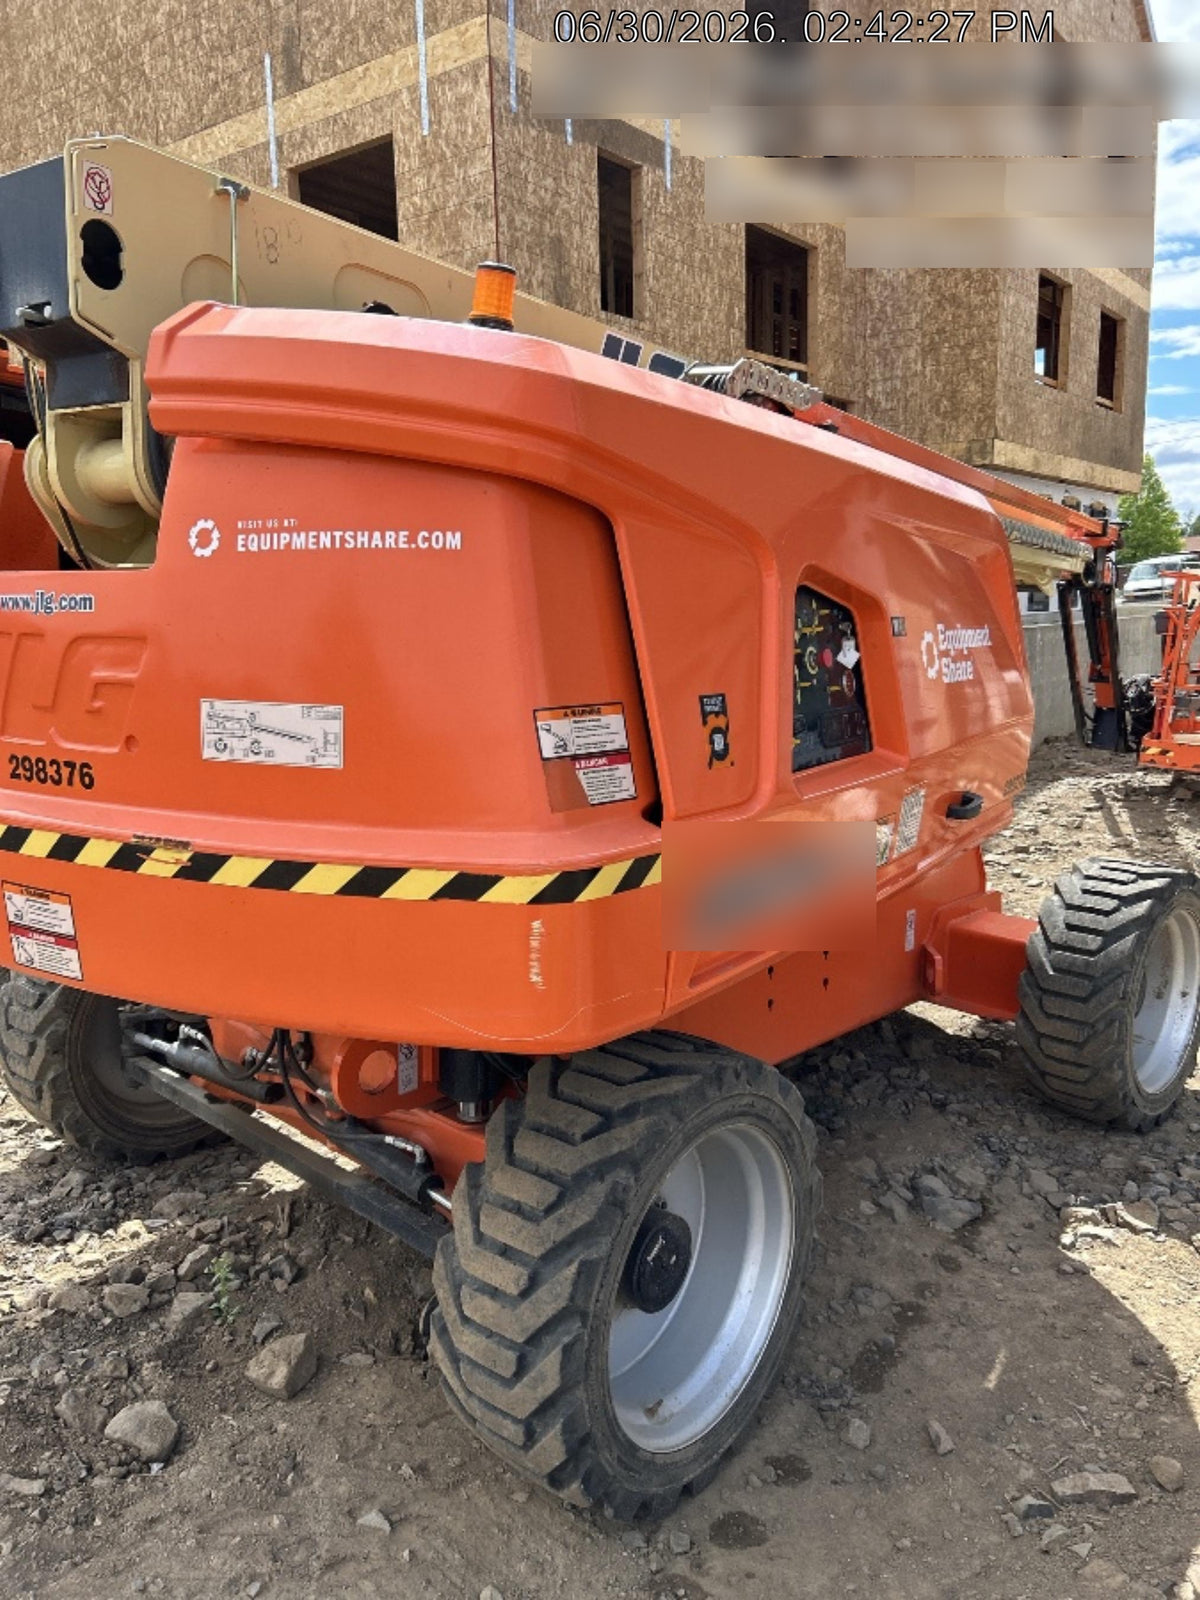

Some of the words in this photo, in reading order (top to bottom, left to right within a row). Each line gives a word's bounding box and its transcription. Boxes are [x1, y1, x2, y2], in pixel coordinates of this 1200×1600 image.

[236, 530, 463, 552] EQUIPMENTSHARE.COM
[936, 623, 992, 656] Equipment
[0, 630, 148, 753] LG
[8, 753, 95, 790] 298376
